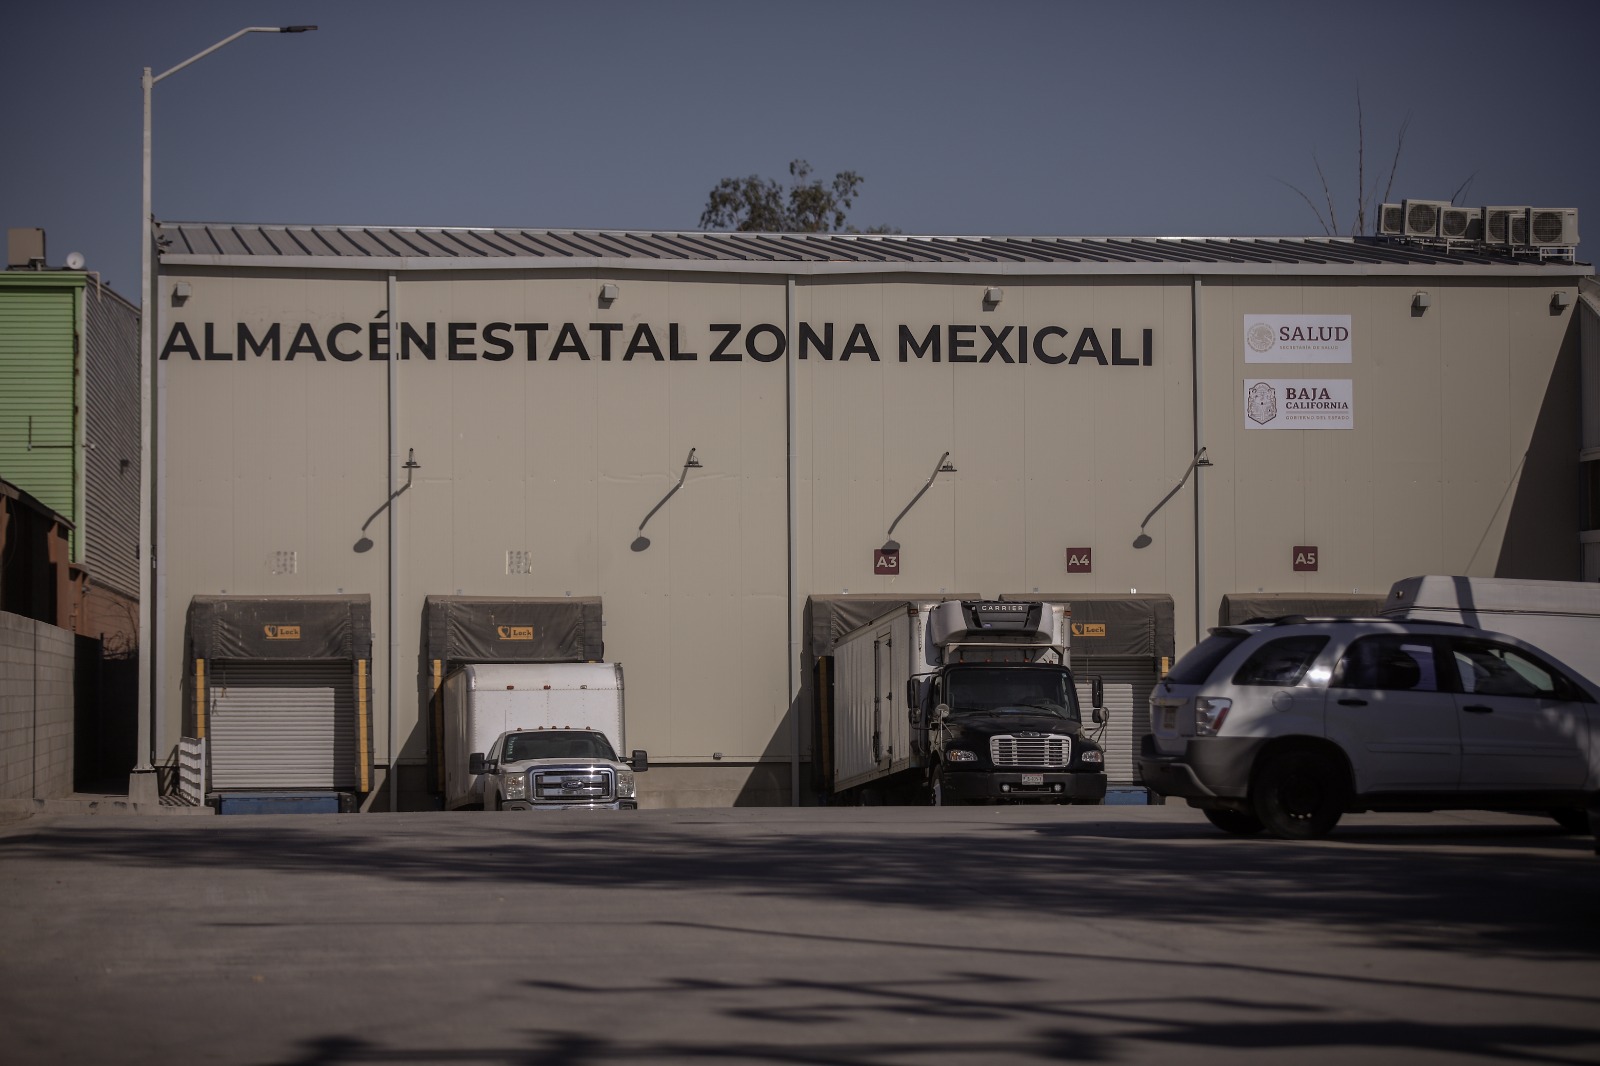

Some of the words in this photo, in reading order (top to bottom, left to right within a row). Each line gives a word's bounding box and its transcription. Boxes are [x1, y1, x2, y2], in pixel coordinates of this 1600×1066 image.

[159, 310, 436, 361] ALMACÉN
[448, 321, 698, 361] ESTATAL
[709, 322, 880, 363] ZONA
[899, 324, 1153, 366] MEXICALI
[1279, 326, 1349, 342] SALUD
[1285, 387, 1331, 401] BAJA
[1285, 401, 1349, 410] CALIFORNIA
[876, 556, 897, 568] A3
[1068, 554, 1090, 566] A4
[1295, 552, 1316, 565] A5
